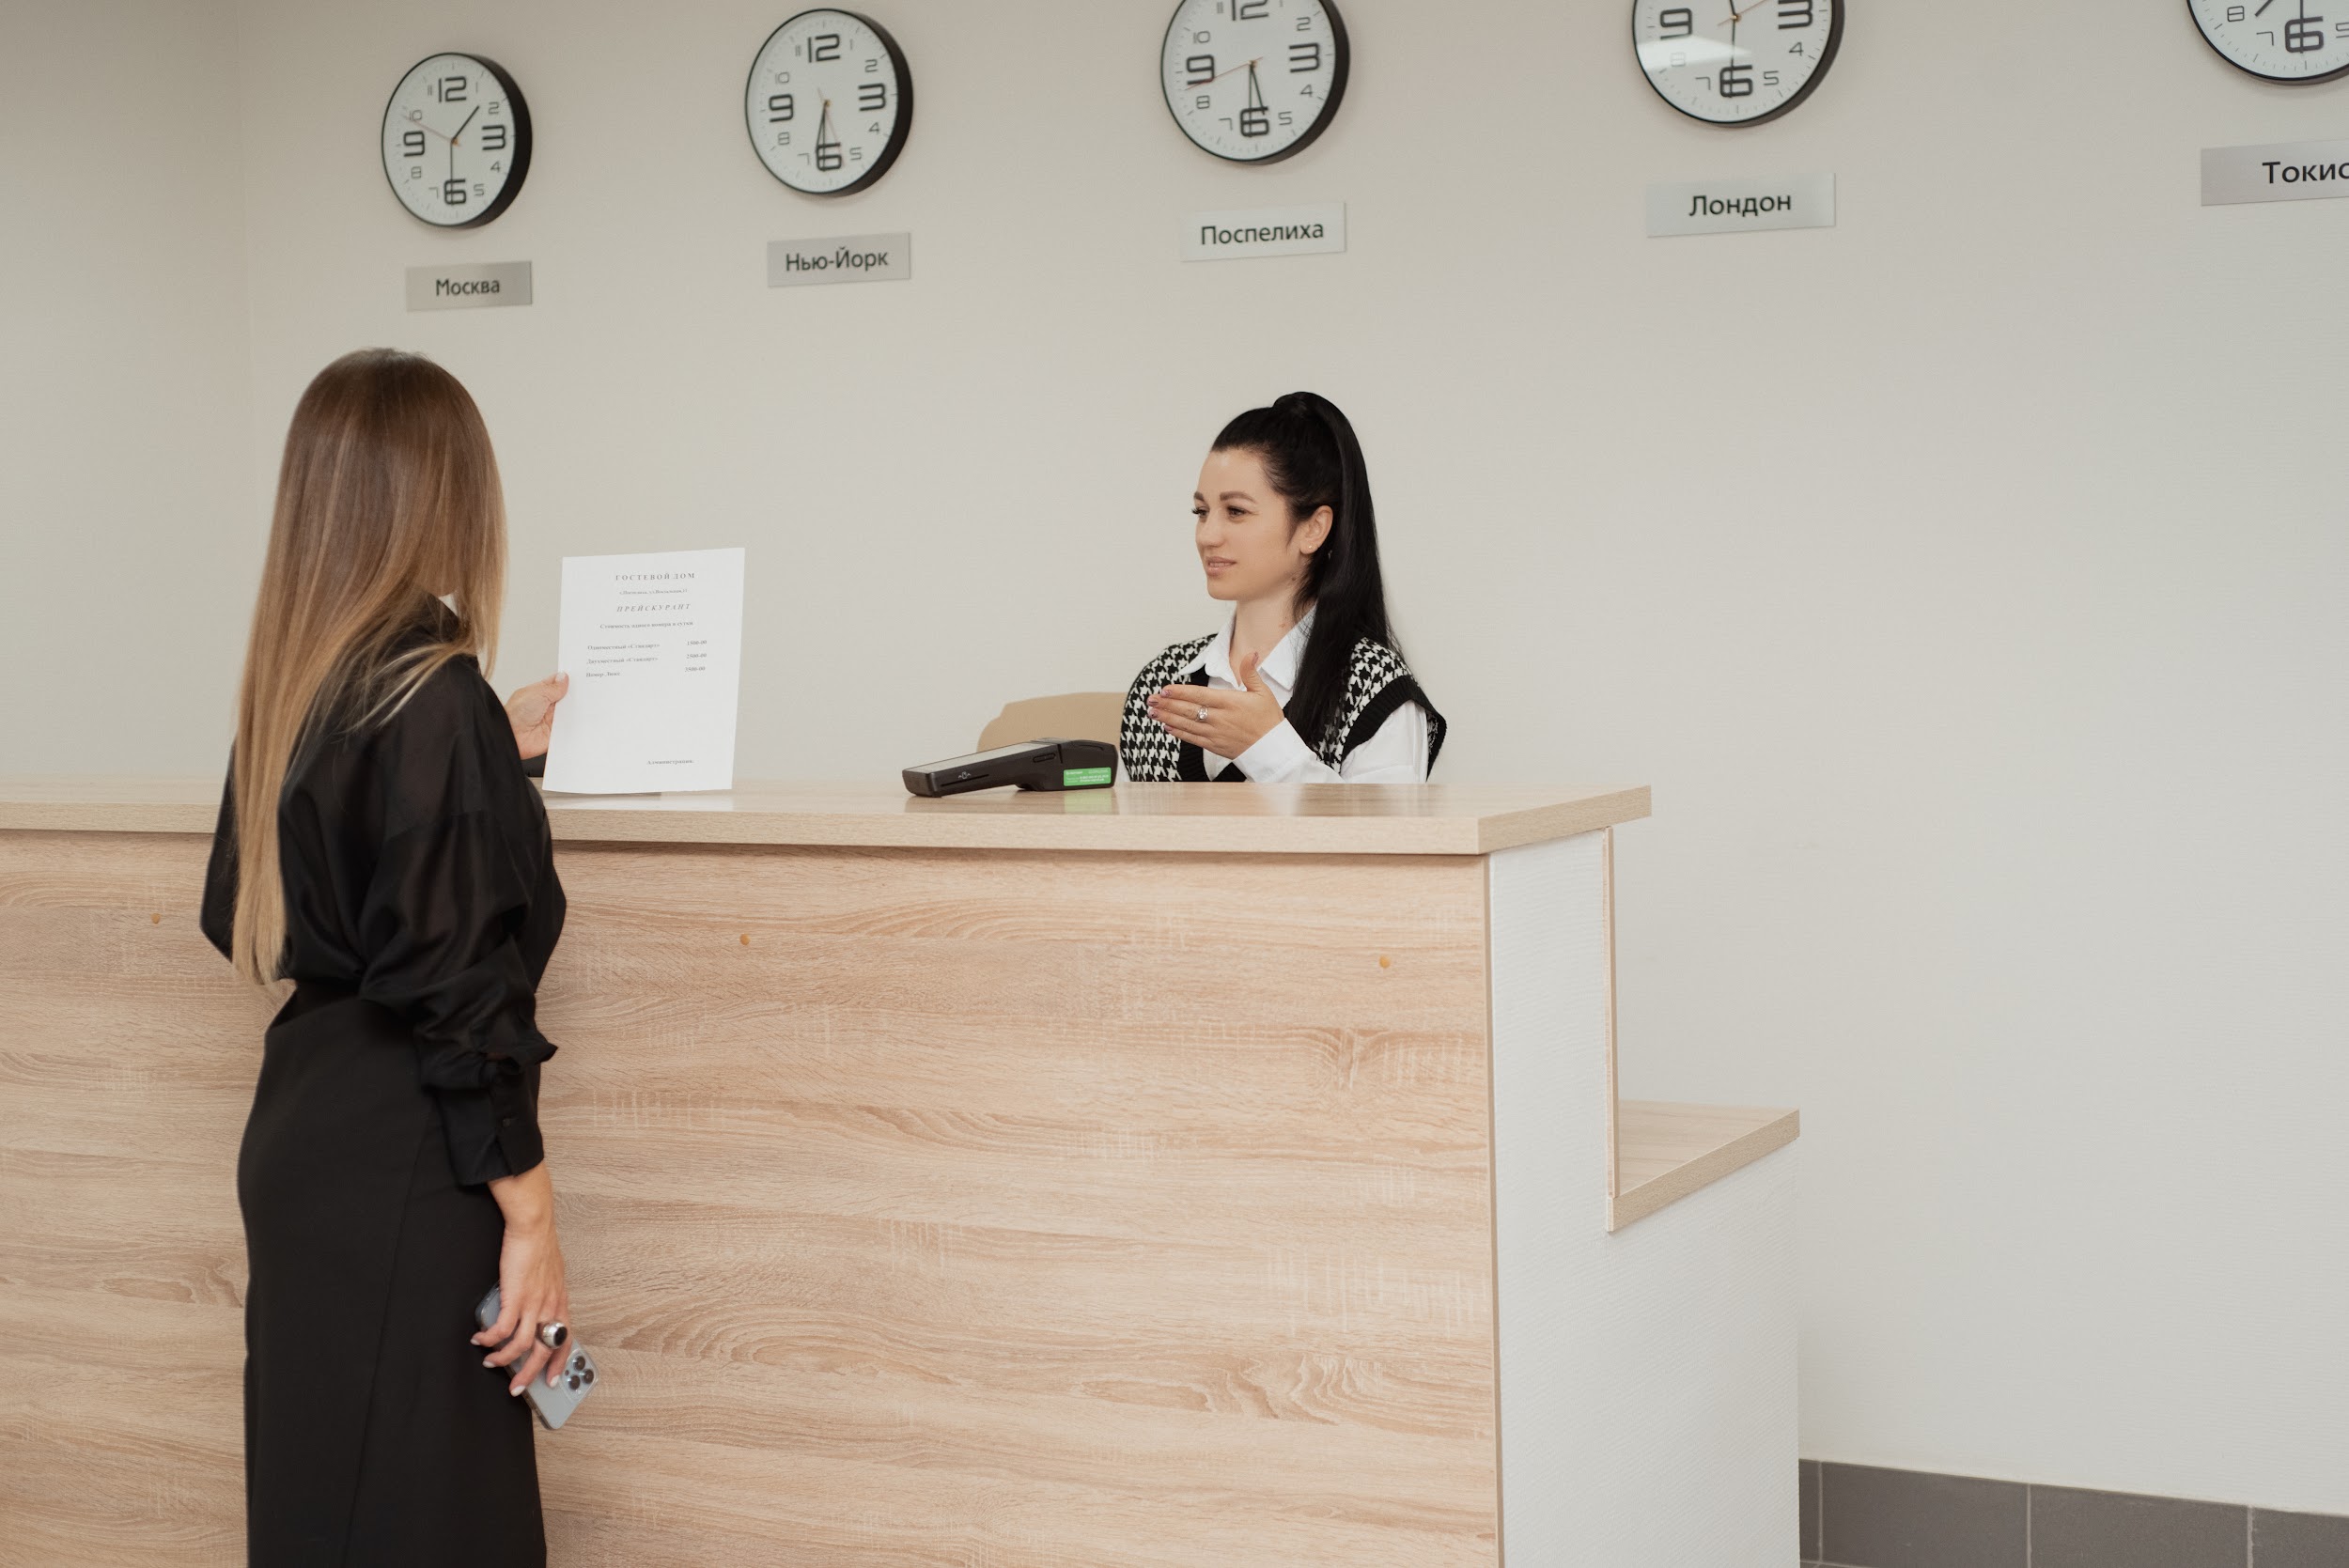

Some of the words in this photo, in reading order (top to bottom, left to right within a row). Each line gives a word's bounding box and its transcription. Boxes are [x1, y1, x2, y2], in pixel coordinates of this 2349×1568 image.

[1778, 0, 1812, 30] 3
[2227, 6, 2245, 23] 8
[1297, 16, 1311, 31] 2
[1659, 8, 1692, 40] 9
[1193, 31, 1210, 43] 10
[2256, 31, 2274, 46] 7
[2284, 16, 2325, 54] 6
[807, 33, 841, 63] 12
[1789, 41, 1804, 56] 4
[1289, 42, 1320, 73] 3
[864, 59, 878, 72] 2
[1187, 54, 1215, 85] 9
[1695, 76, 1711, 90] 7
[1719, 65, 1753, 98] 6
[1764, 70, 1779, 85] 5
[438, 75, 467, 103] 12
[1300, 85, 1314, 98] 4
[858, 83, 886, 112] 3
[1196, 95, 1210, 109] 8
[489, 101, 500, 115] 2
[769, 94, 794, 123] 9
[1219, 117, 1233, 131] 7
[1240, 106, 1269, 137] 6
[1278, 111, 1293, 126] 5
[869, 122, 880, 134] 4
[403, 131, 426, 157] 9
[482, 124, 506, 150] 3
[778, 132, 790, 146] 8
[798, 153, 810, 165] 7
[816, 142, 842, 171] 6
[849, 147, 863, 161] 5
[411, 166, 422, 179] 8
[490, 162, 501, 173] 4
[428, 187, 439, 199] 7
[443, 179, 467, 205] 6
[474, 183, 485, 196] 5
[1688, 194, 1792, 217] Лондон
[1201, 223, 1324, 245] Поспелиха
[786, 246, 889, 272] Нью-Йорк
[435, 278, 500, 296] Москва
[615, 572, 670, 581] ГОСТЕВОЙ
[616, 603, 691, 612] ПРЕЙСКУРАНТ
